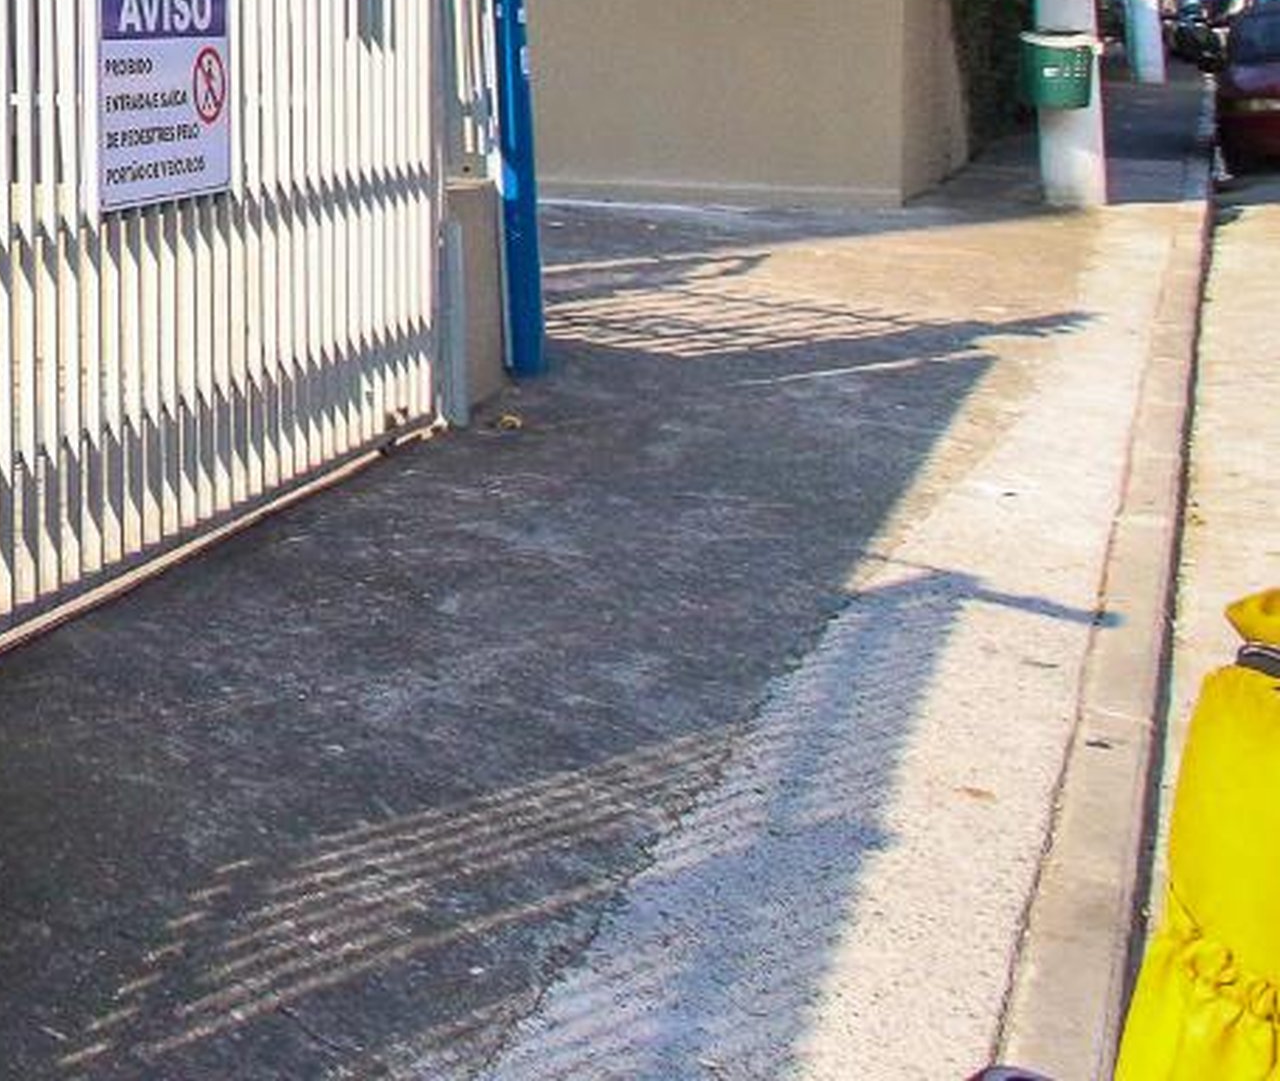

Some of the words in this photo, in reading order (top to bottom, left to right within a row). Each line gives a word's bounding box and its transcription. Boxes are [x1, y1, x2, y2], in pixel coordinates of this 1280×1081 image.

[105, 58, 153, 77] PROIBIDO
[106, 92, 151, 114] ENTRADA
[106, 132, 119, 149] DE
[121, 126, 175, 147] PEDESTRES
[177, 122, 200, 142] PELO
